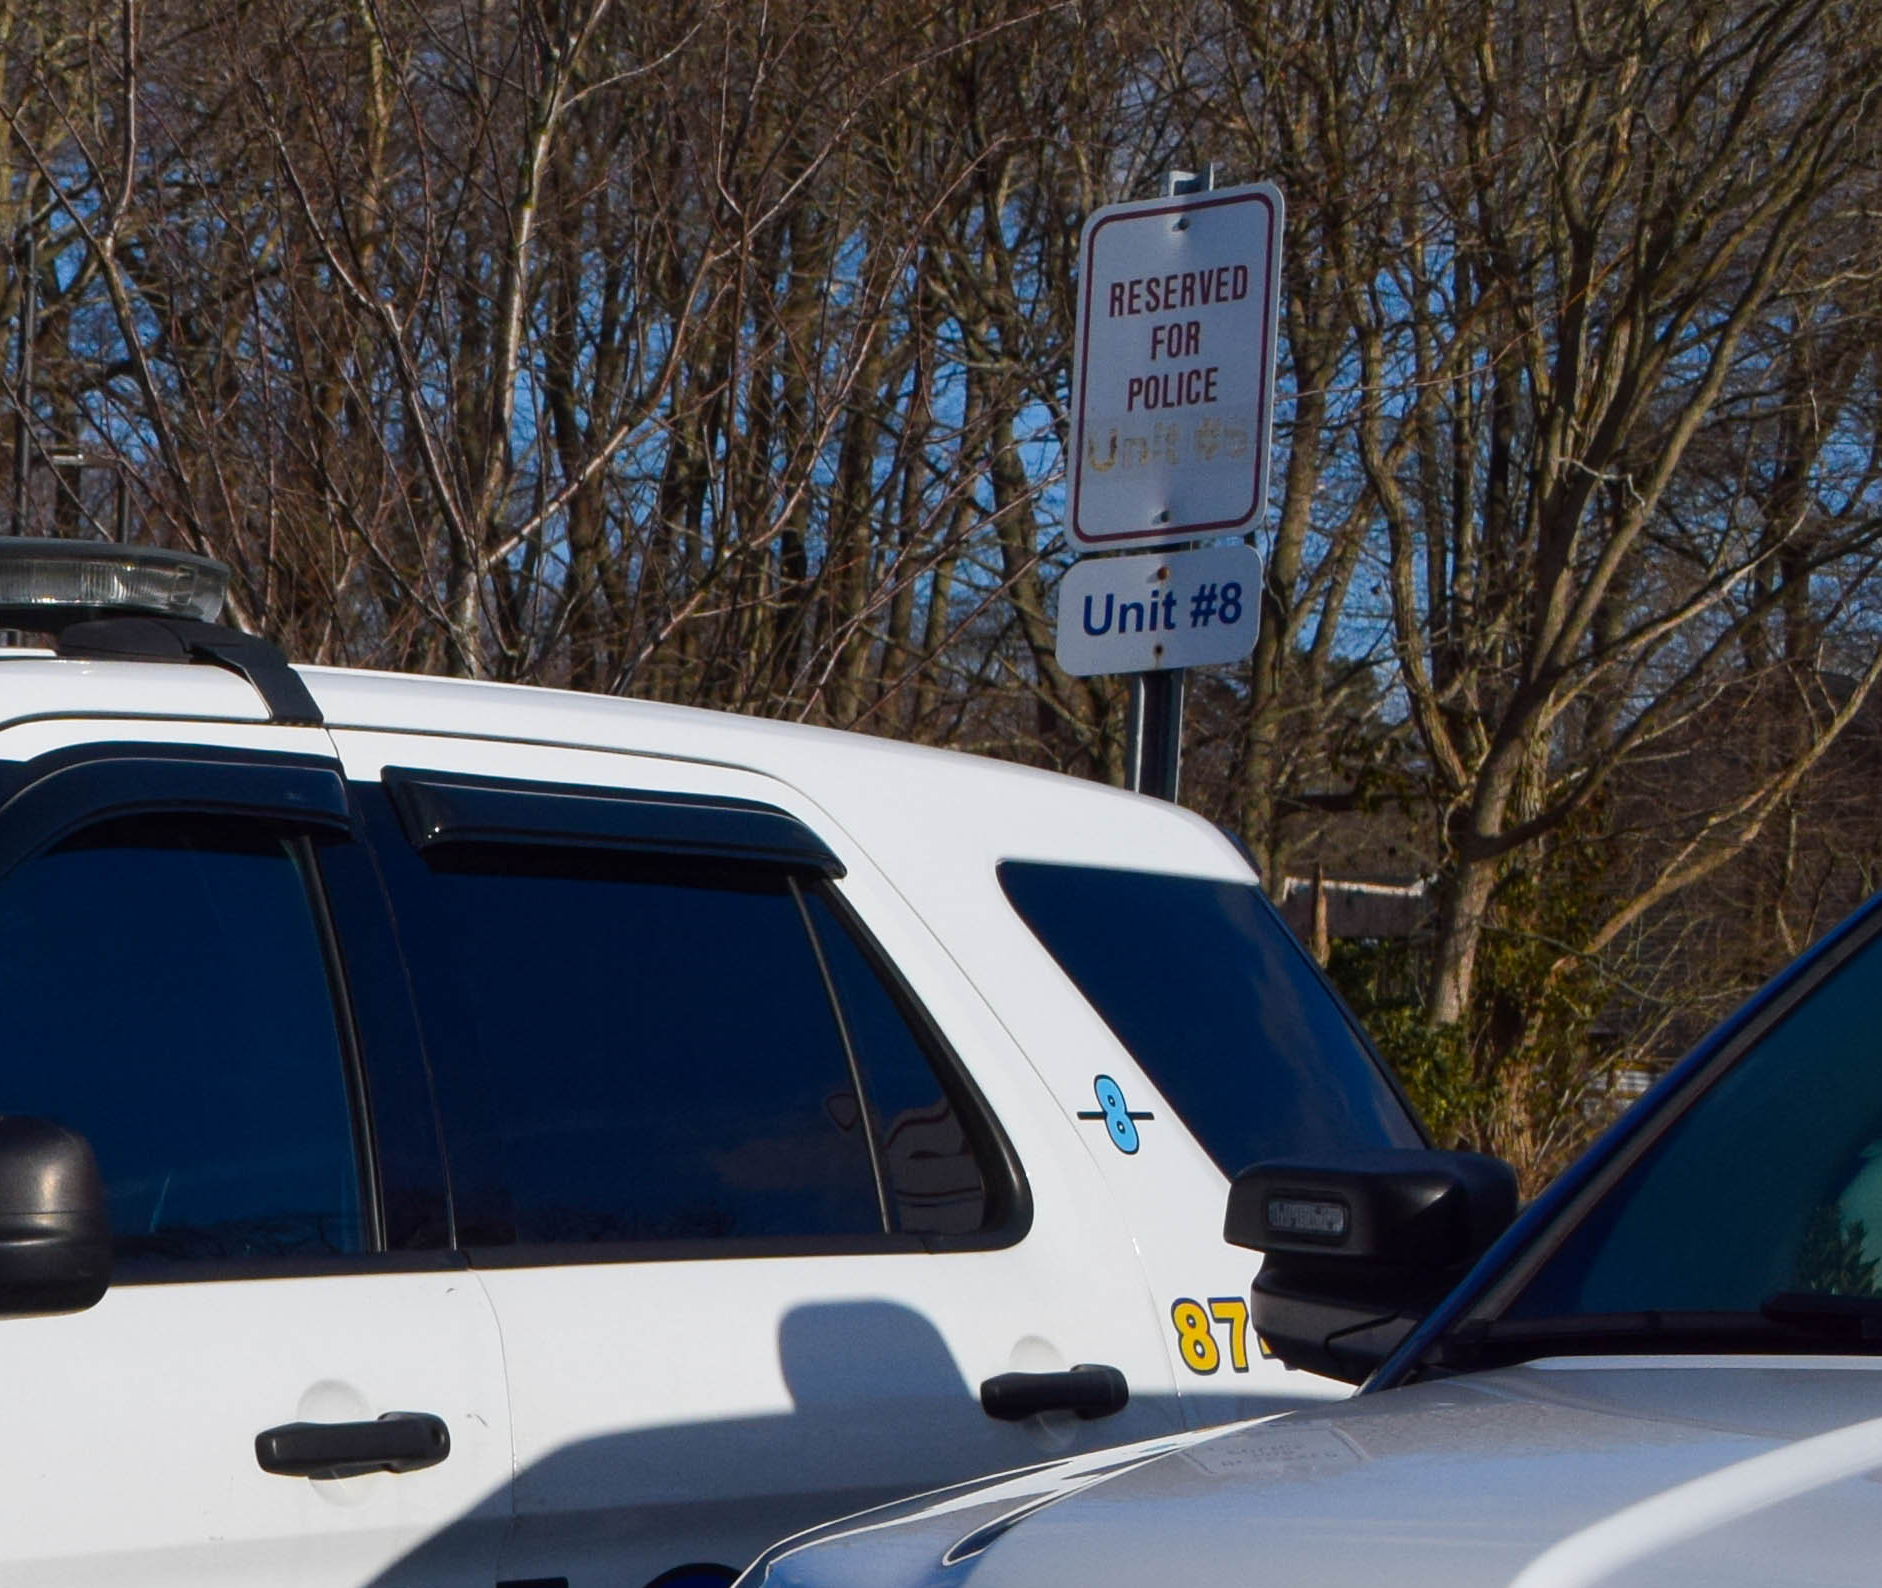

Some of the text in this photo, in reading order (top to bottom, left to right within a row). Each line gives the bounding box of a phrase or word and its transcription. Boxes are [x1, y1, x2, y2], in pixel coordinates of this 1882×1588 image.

[1109, 265, 1248, 318] RESERVED
[1151, 320, 1200, 360] FOR
[1126, 367, 1218, 412] POLICE
[1082, 581, 1243, 637] Unit #8
[1093, 1074, 1140, 1155] 8
[1170, 1297, 1300, 1376] 87
